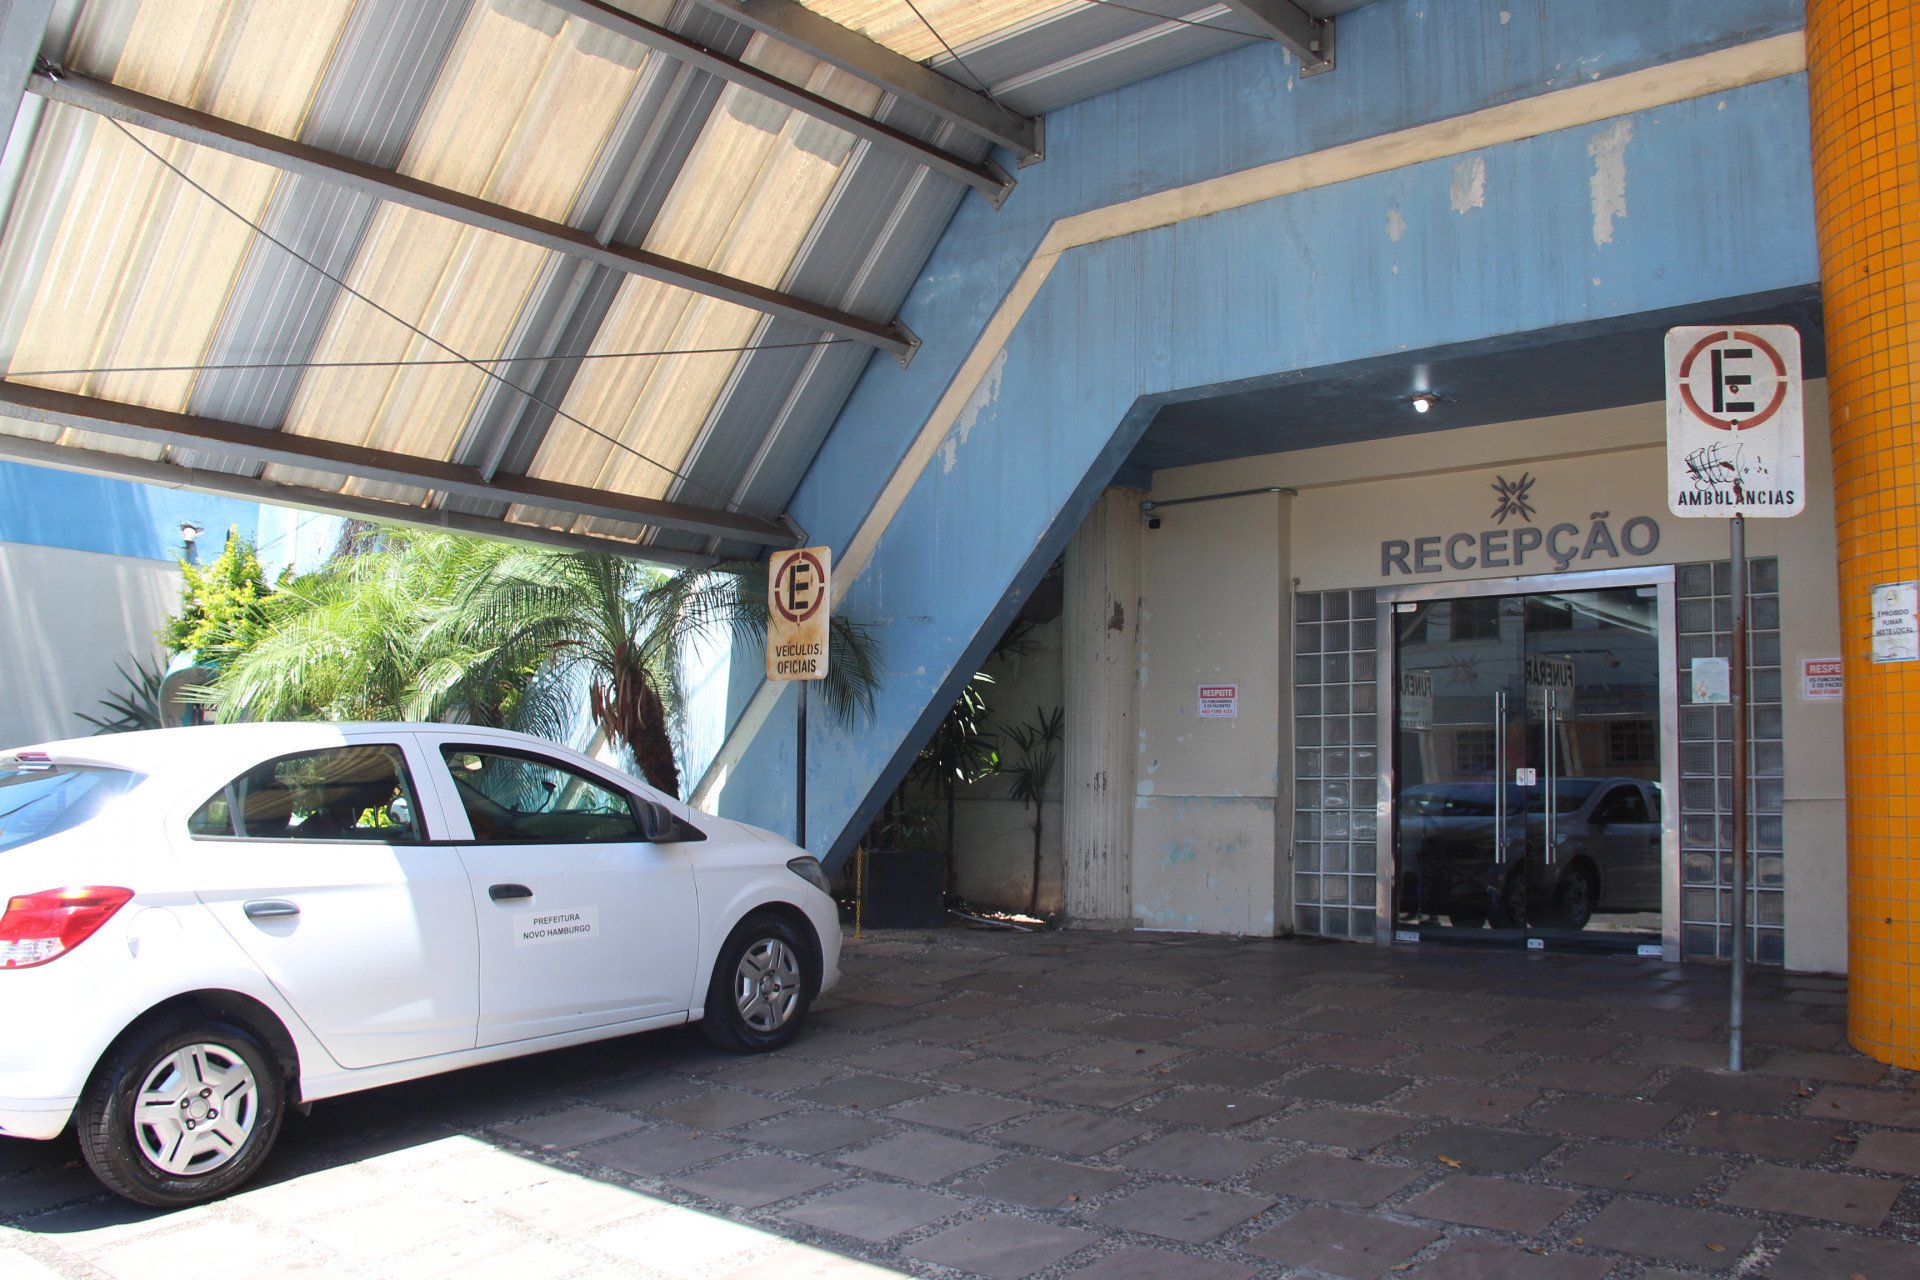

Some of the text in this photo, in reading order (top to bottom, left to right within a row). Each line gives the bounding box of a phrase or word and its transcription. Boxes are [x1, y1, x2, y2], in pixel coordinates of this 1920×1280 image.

[1711, 349, 1755, 413] E
[1381, 511, 1660, 576] RECEPÇÃO
[789, 563, 810, 610] E
[1881, 609, 1909, 617] PROIBIDO
[1893, 627, 1914, 635] LOCAL
[777, 659, 816, 674] OFICIAIS
[1202, 689, 1233, 697] RESPEITE
[533, 913, 580, 926] PREFEITURA
[523, 924, 591, 940] NOVO HAMBURGO
